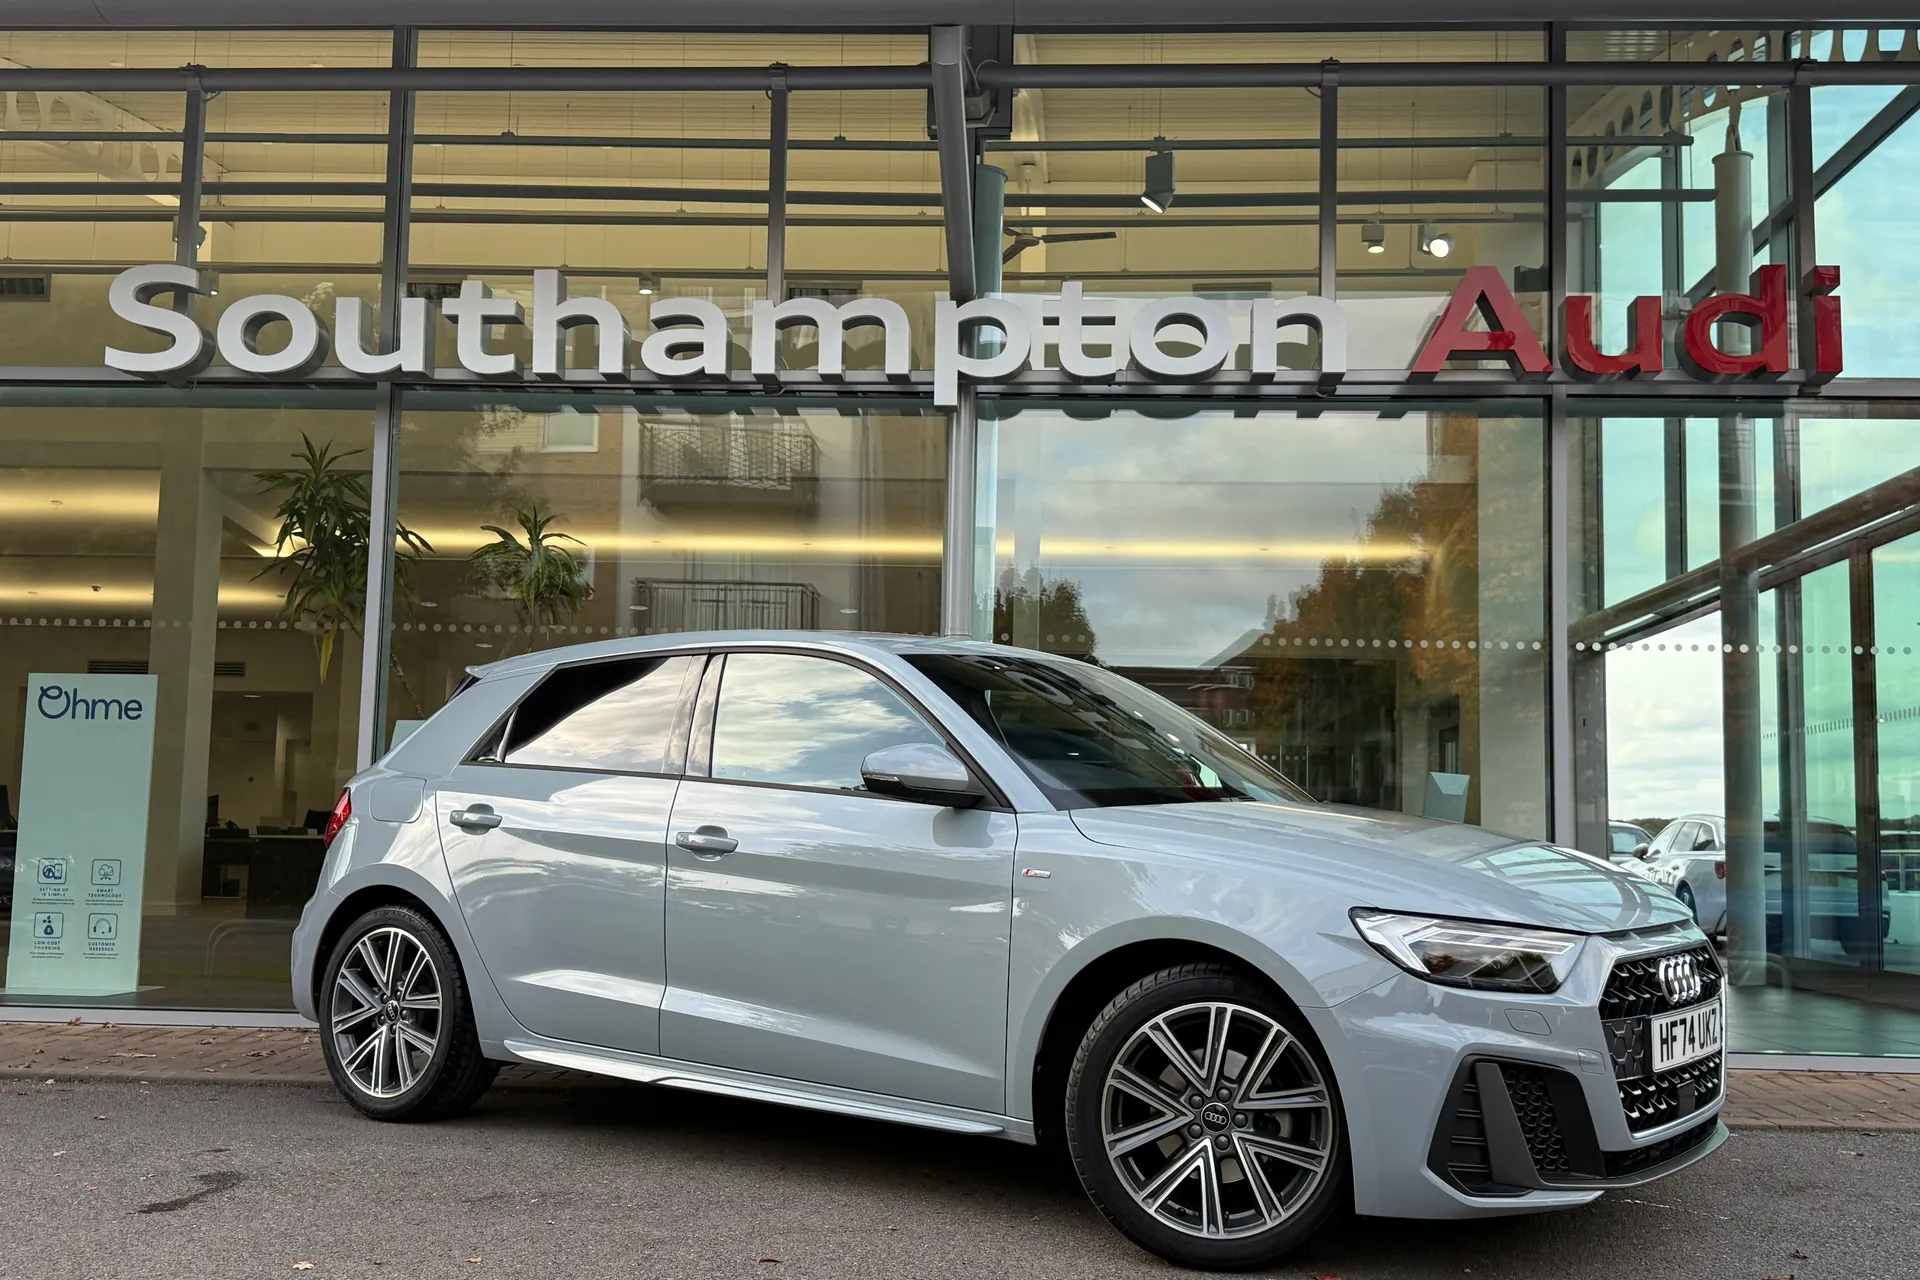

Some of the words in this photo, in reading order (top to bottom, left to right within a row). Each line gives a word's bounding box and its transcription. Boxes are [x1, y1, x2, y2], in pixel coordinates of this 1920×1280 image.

[104, 263, 1349, 407] Southampton
[1411, 264, 1844, 376] Audi
[38, 685, 143, 720] Ohme
[1660, 1014, 1695, 1063] HF74
[1699, 1007, 1718, 1051] UKZ
